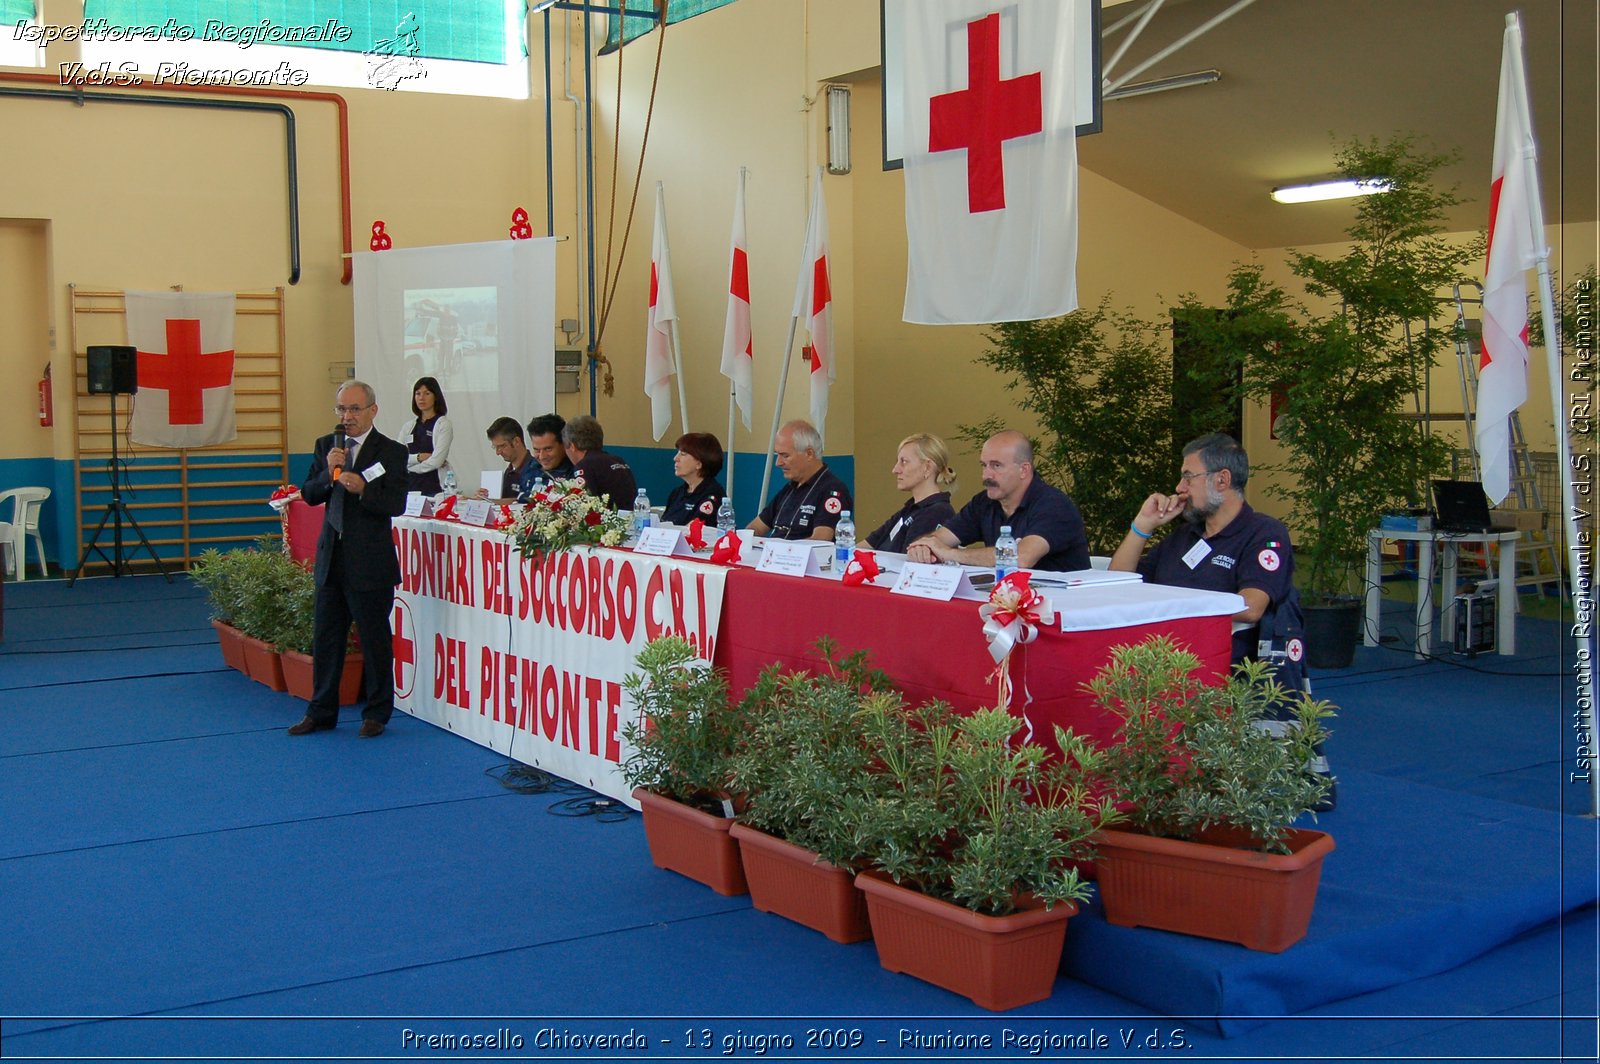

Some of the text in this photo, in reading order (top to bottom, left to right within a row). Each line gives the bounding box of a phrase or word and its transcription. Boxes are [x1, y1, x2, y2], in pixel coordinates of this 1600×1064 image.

[392, 526, 714, 661] OLONTARI DEL SOCCORSO C.R.I.
[434, 633, 622, 763] DEL PIEMONTE
